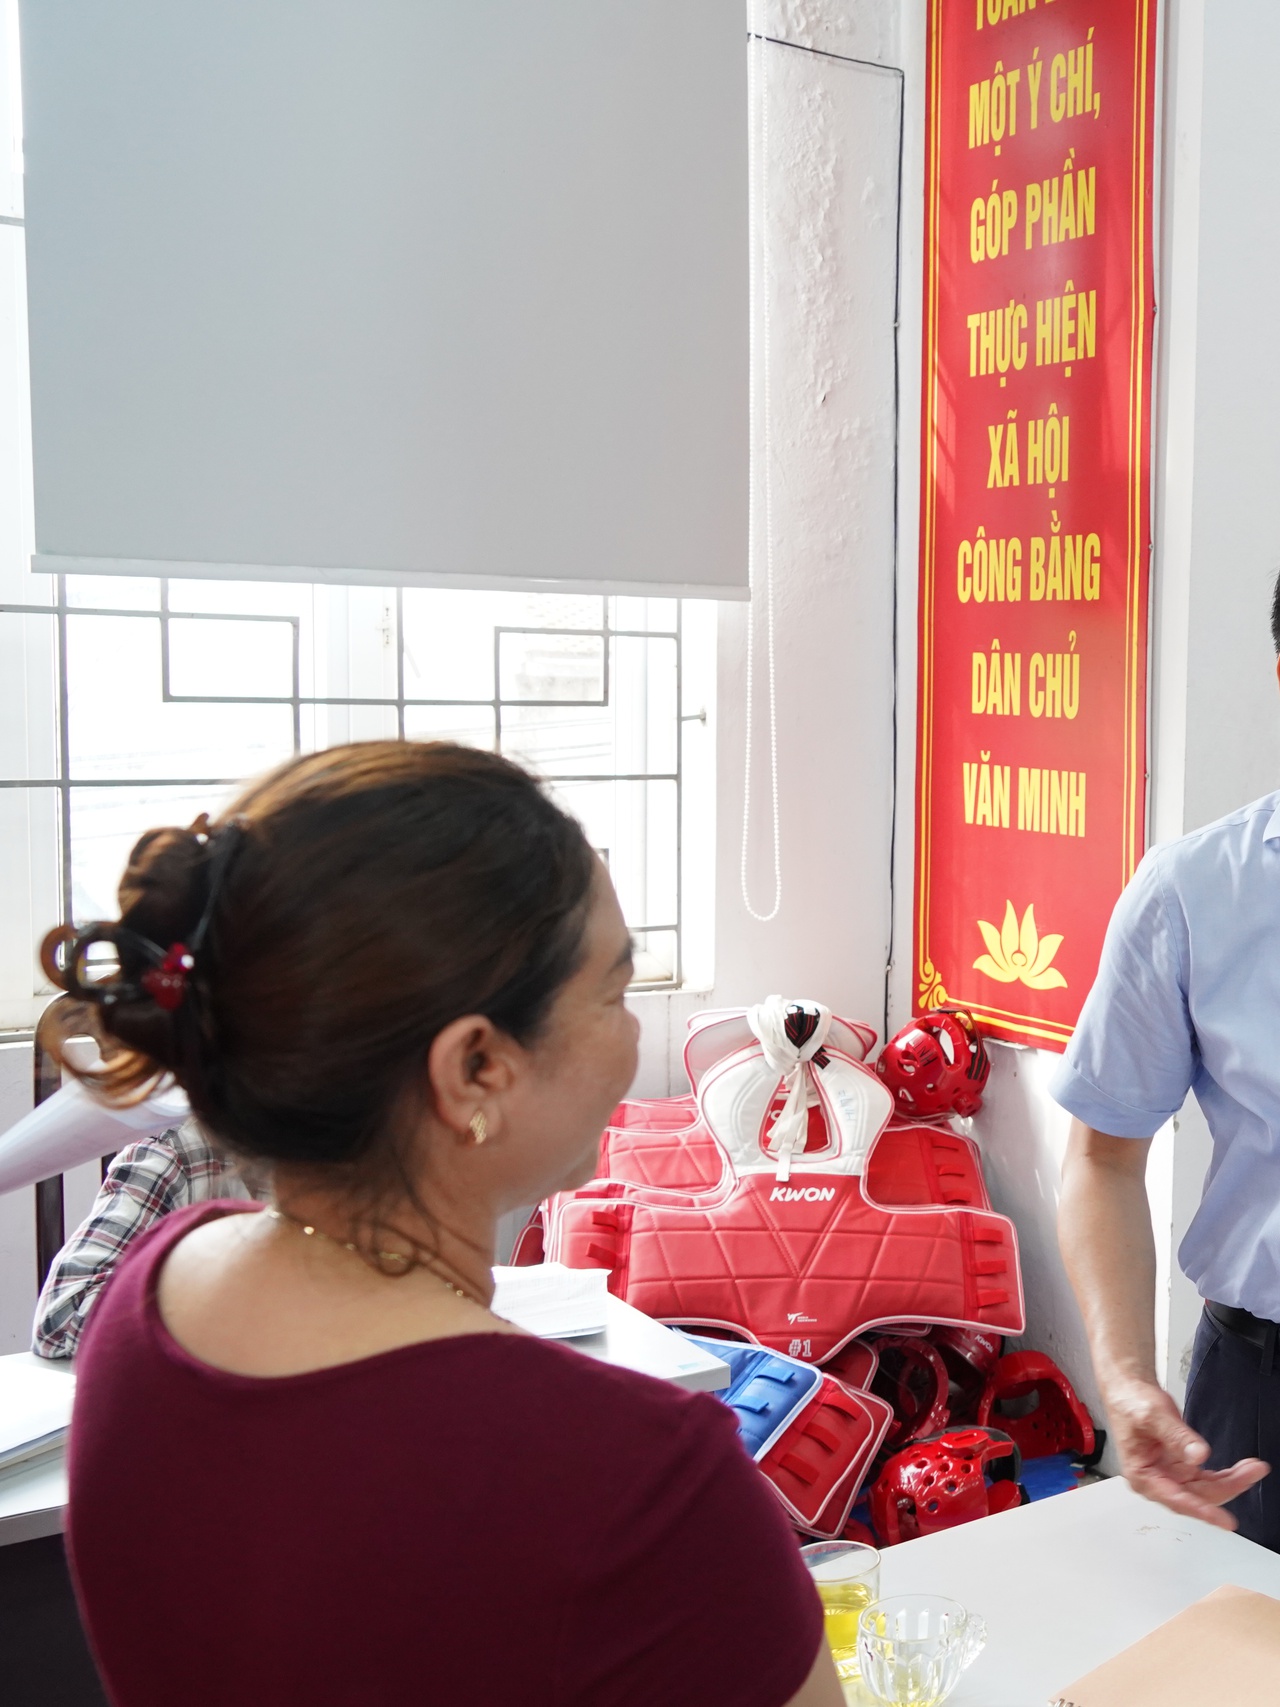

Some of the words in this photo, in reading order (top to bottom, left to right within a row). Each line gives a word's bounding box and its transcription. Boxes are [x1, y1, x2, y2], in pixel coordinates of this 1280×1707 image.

[969, 61, 1020, 156] MỘT
[1028, 48, 1042, 128] Ý
[1050, 27, 1100, 122] CHÍ,
[970, 179, 1017, 263] GÓP
[1025, 148, 1095, 249] PHẦN
[967, 300, 1027, 387] THỰC
[1036, 280, 1096, 377] HIỆN
[987, 410, 1019, 488] XÃ
[1028, 403, 1069, 498] HỘI
[958, 526, 1022, 603] CÔNG
[1030, 510, 1100, 601] BẰNG
[972, 639, 1021, 716] DÂN
[1029, 630, 1080, 720] CHỦ
[963, 751, 1010, 828] VĂN
[1018, 767, 1086, 837] MINH
[769, 1187, 835, 1202] KWON
[789, 1339, 812, 1357] #1
